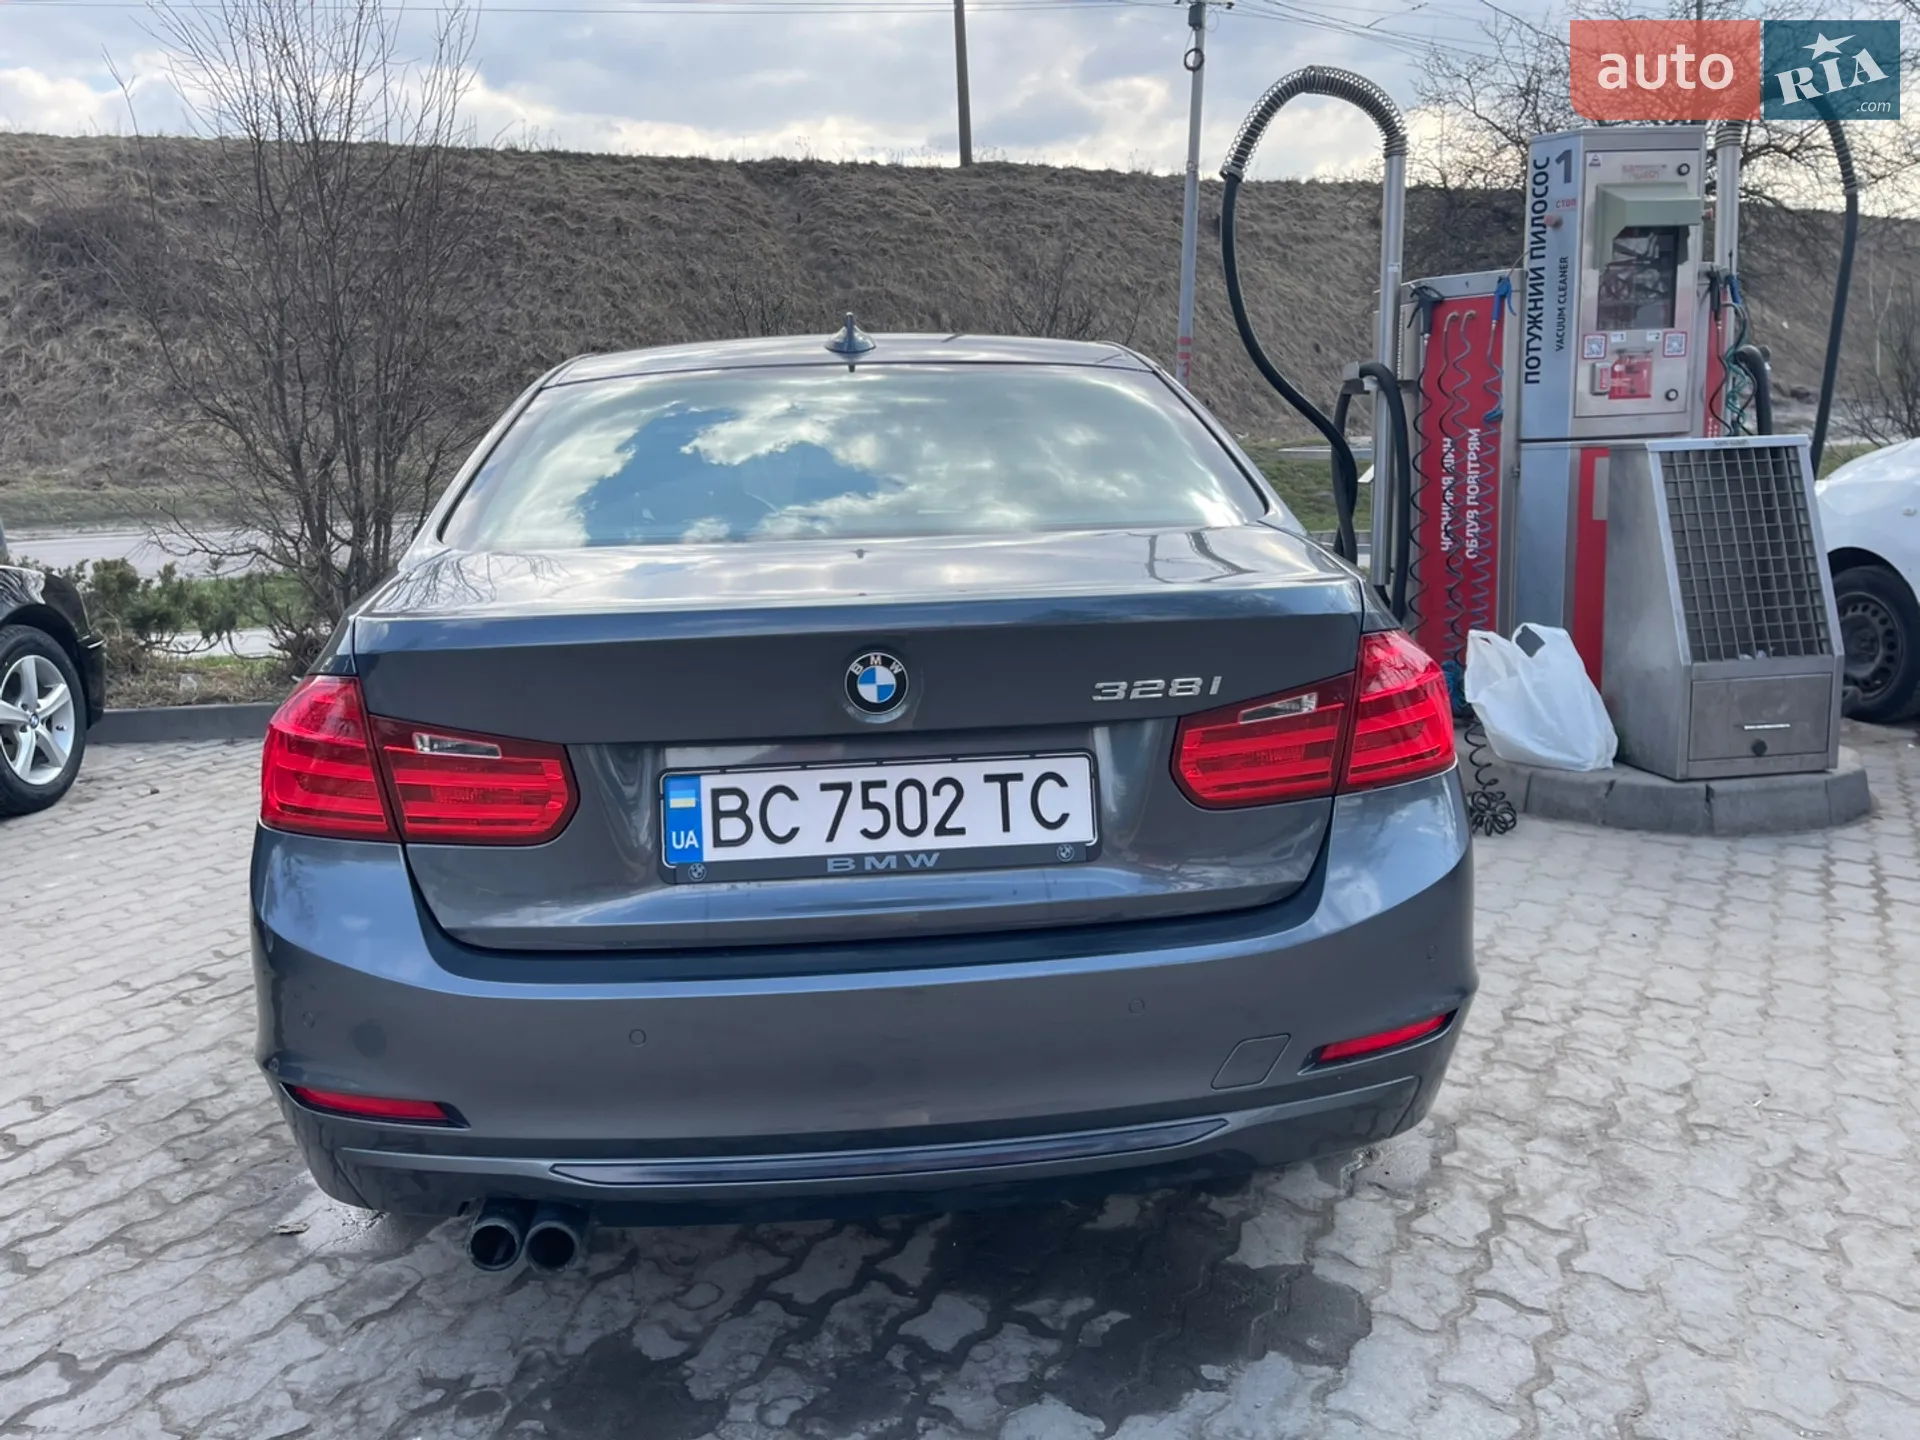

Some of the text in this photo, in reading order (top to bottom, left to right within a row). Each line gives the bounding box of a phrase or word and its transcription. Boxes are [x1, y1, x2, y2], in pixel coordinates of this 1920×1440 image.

[1555, 149, 1572, 184] 1
[1524, 156, 1550, 384] ПОТУЖНИЙ ПИЛОСОС
[1555, 256, 1569, 352] VACUUM CLEANER
[1466, 428, 1481, 505] ПОВІТРЯМ
[850, 654, 903, 676] BMW
[710, 771, 1070, 848] BC 7502 TC
[672, 829, 699, 850] UA
[827, 852, 940, 872] BMW
